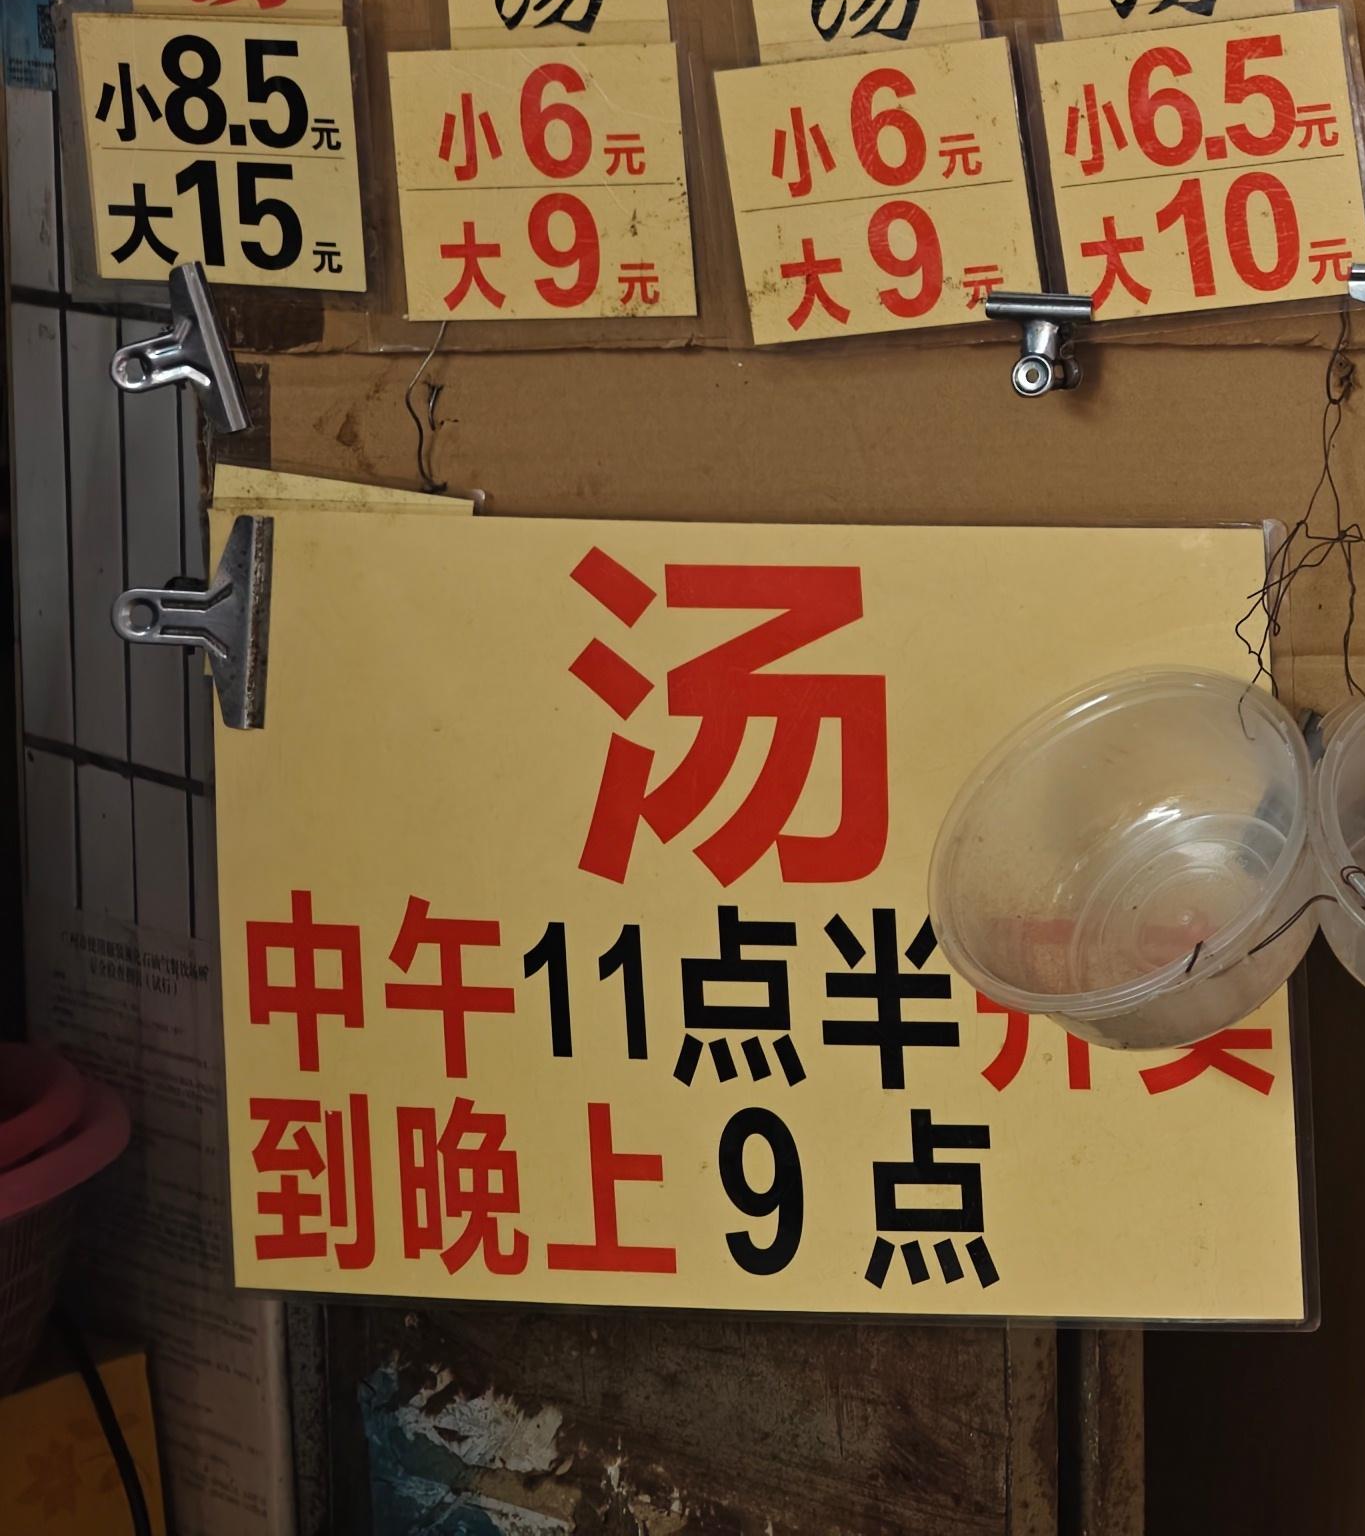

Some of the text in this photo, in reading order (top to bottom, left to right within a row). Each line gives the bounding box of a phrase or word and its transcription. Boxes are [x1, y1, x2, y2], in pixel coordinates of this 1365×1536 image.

[95, 34, 342, 154] 小8.5元
[438, 63, 647, 182] 小6元
[770, 67, 983, 198] 小6元
[1063, 33, 1340, 177] 小6.5元
[107, 159, 344, 275] 大15元
[439, 192, 660, 311] 大9元
[779, 199, 1005, 331] 大9元
[1079, 171, 1353, 307] 大10元
[568, 546, 890, 888] 汤
